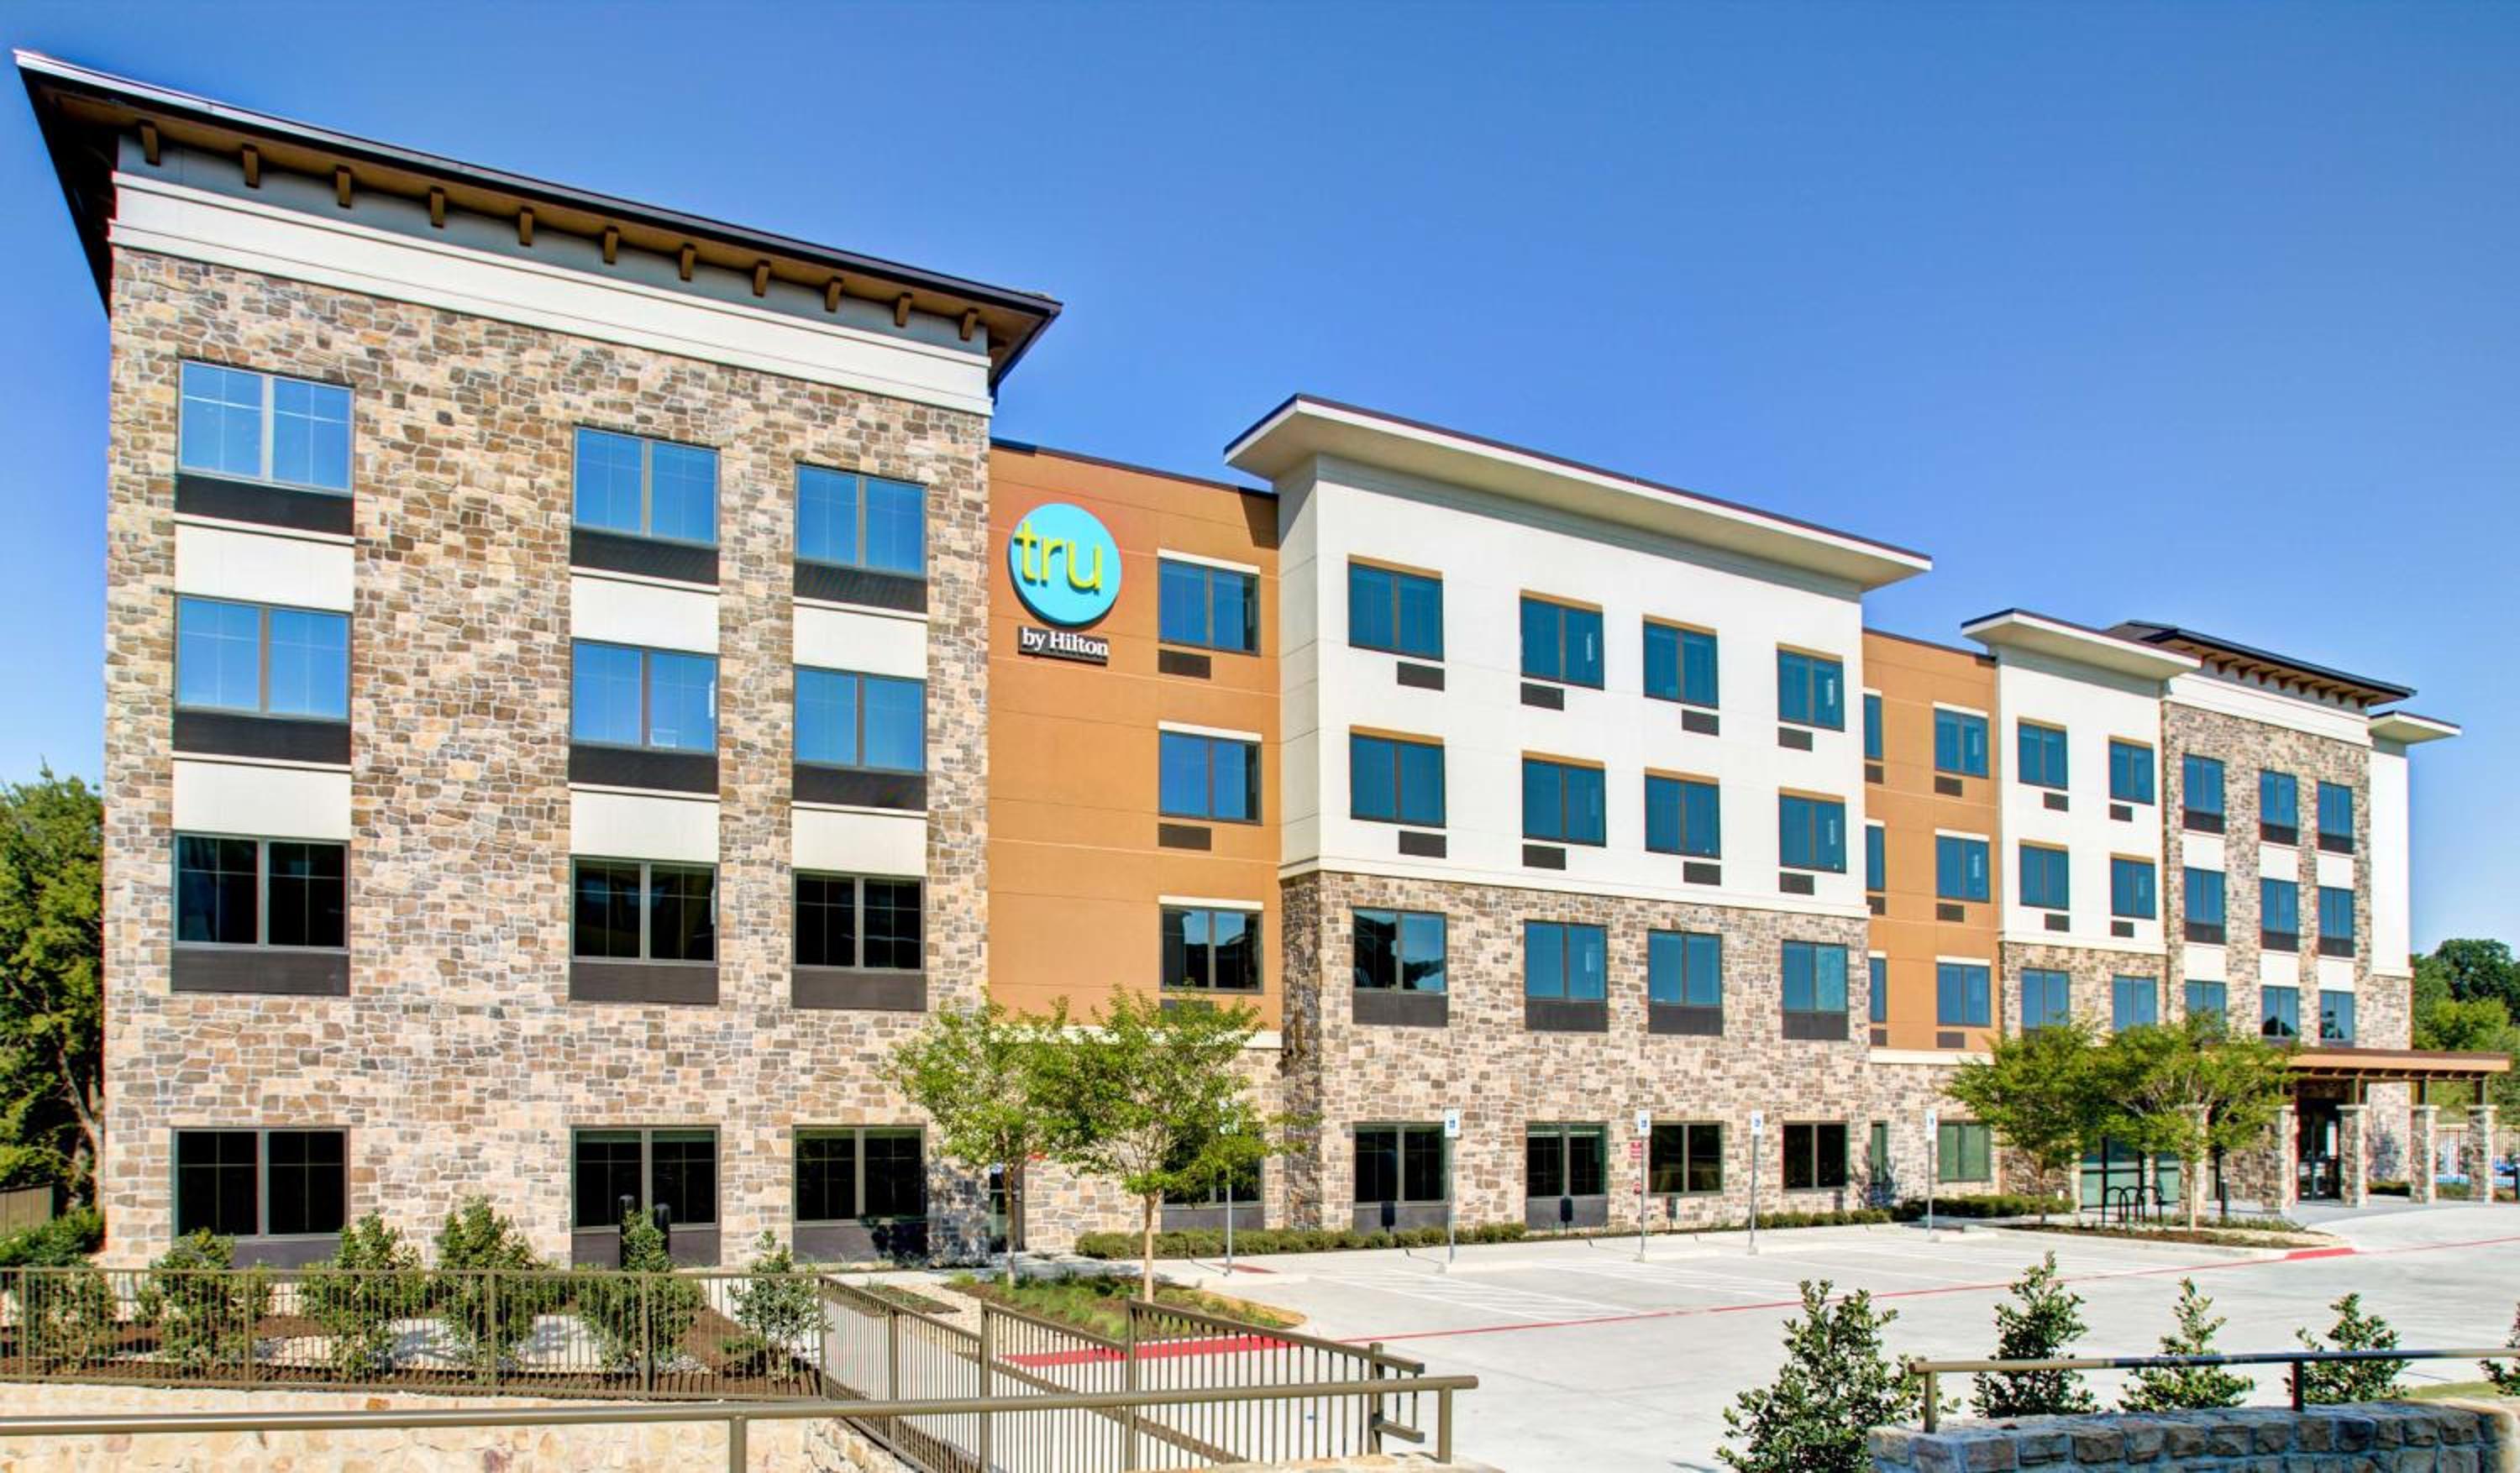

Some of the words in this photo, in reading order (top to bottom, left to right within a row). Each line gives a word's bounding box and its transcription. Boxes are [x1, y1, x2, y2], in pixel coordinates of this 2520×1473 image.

[1014, 520, 1102, 590] tru
[1022, 627, 1045, 651] by
[1049, 631, 1108, 655] Hilton
